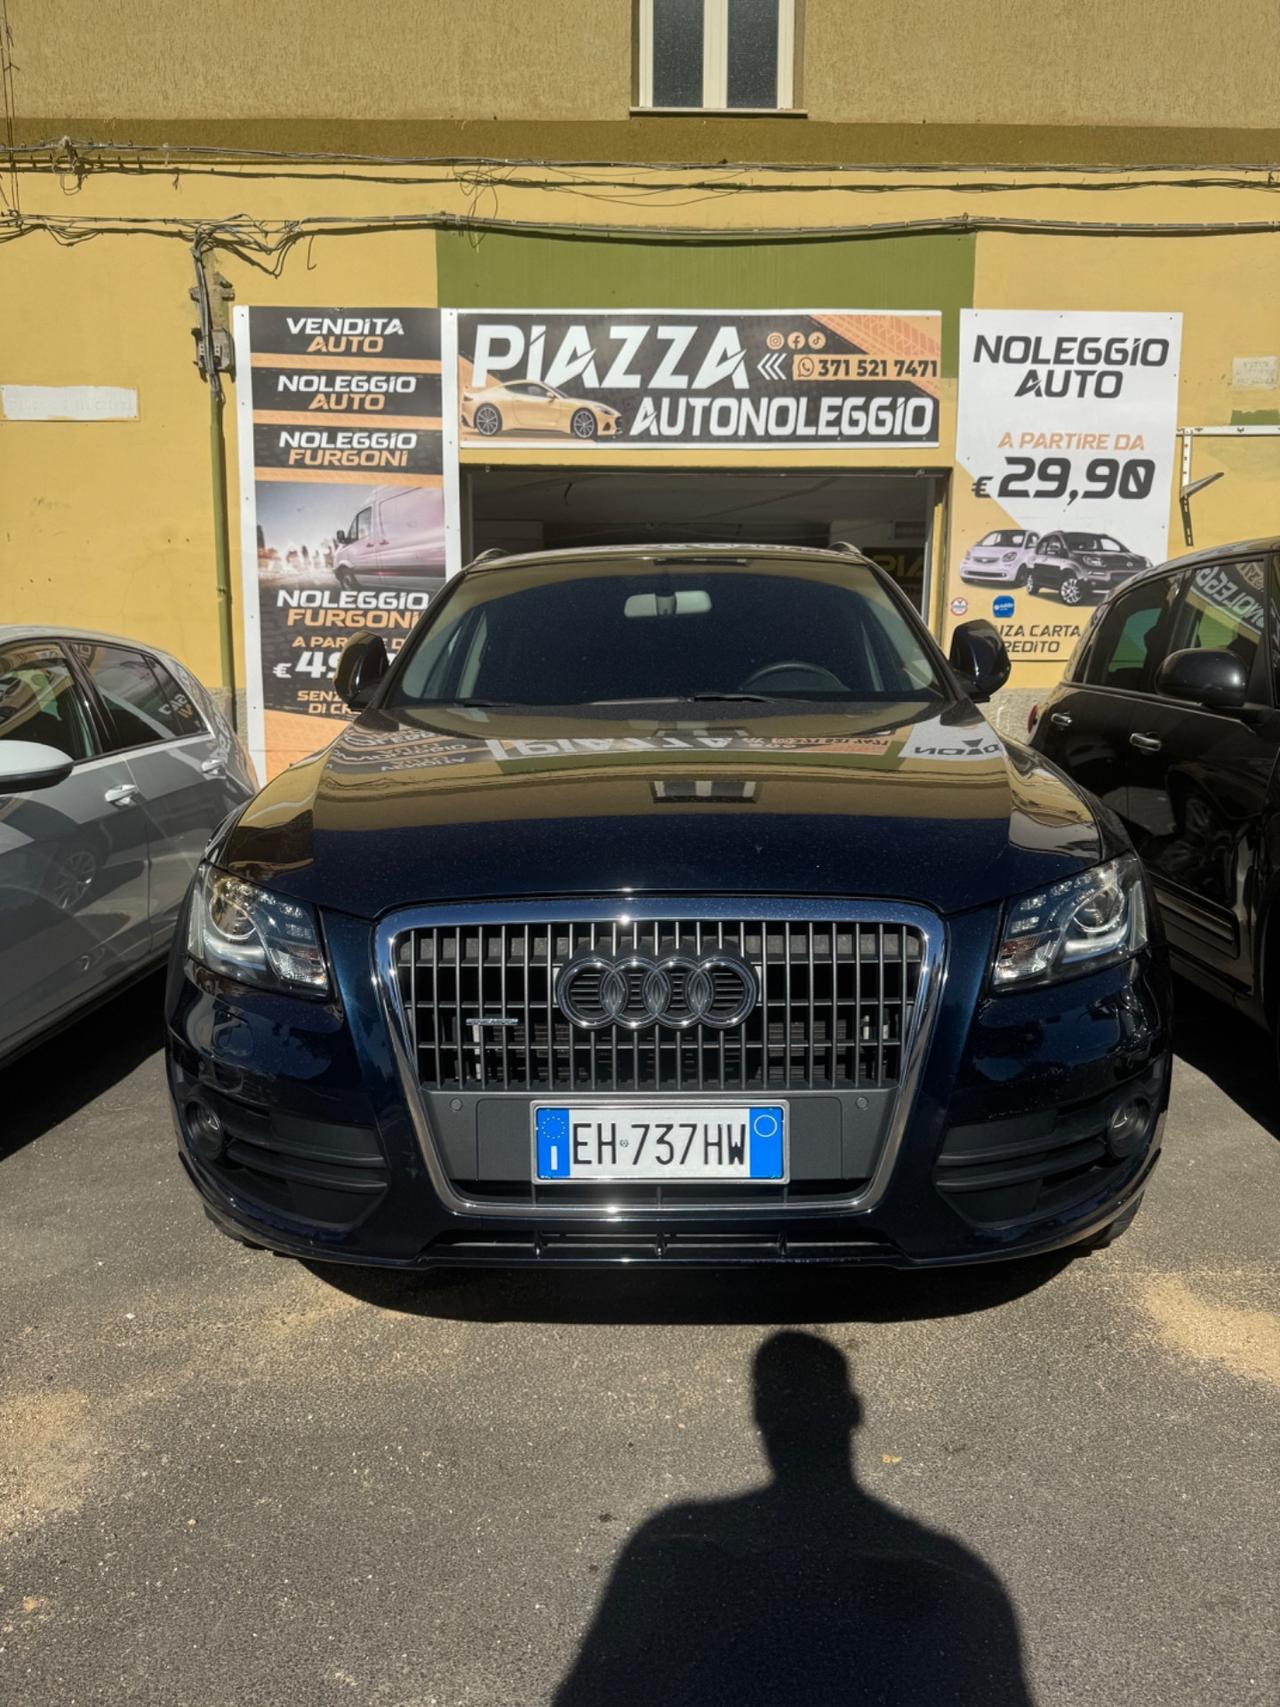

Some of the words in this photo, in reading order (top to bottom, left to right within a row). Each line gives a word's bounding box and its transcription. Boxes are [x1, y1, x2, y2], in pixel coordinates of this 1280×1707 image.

[306, 335, 384, 353] AUTO
[471, 324, 750, 390] PIAZZA
[818, 359, 850, 377] 371
[856, 359, 887, 377] 521
[893, 359, 938, 377] 7471
[1014, 369, 1124, 399] AUTO
[307, 393, 386, 411] AUTO
[997, 431, 1014, 449] A
[1114, 433, 1145, 451] DA
[1029, 624, 1081, 638] CARTA
[291, 635, 306, 649] A
[308, 702, 326, 715] DI
[572, 1122, 617, 1165] EH
[630, 1122, 746, 1166] 737HW
